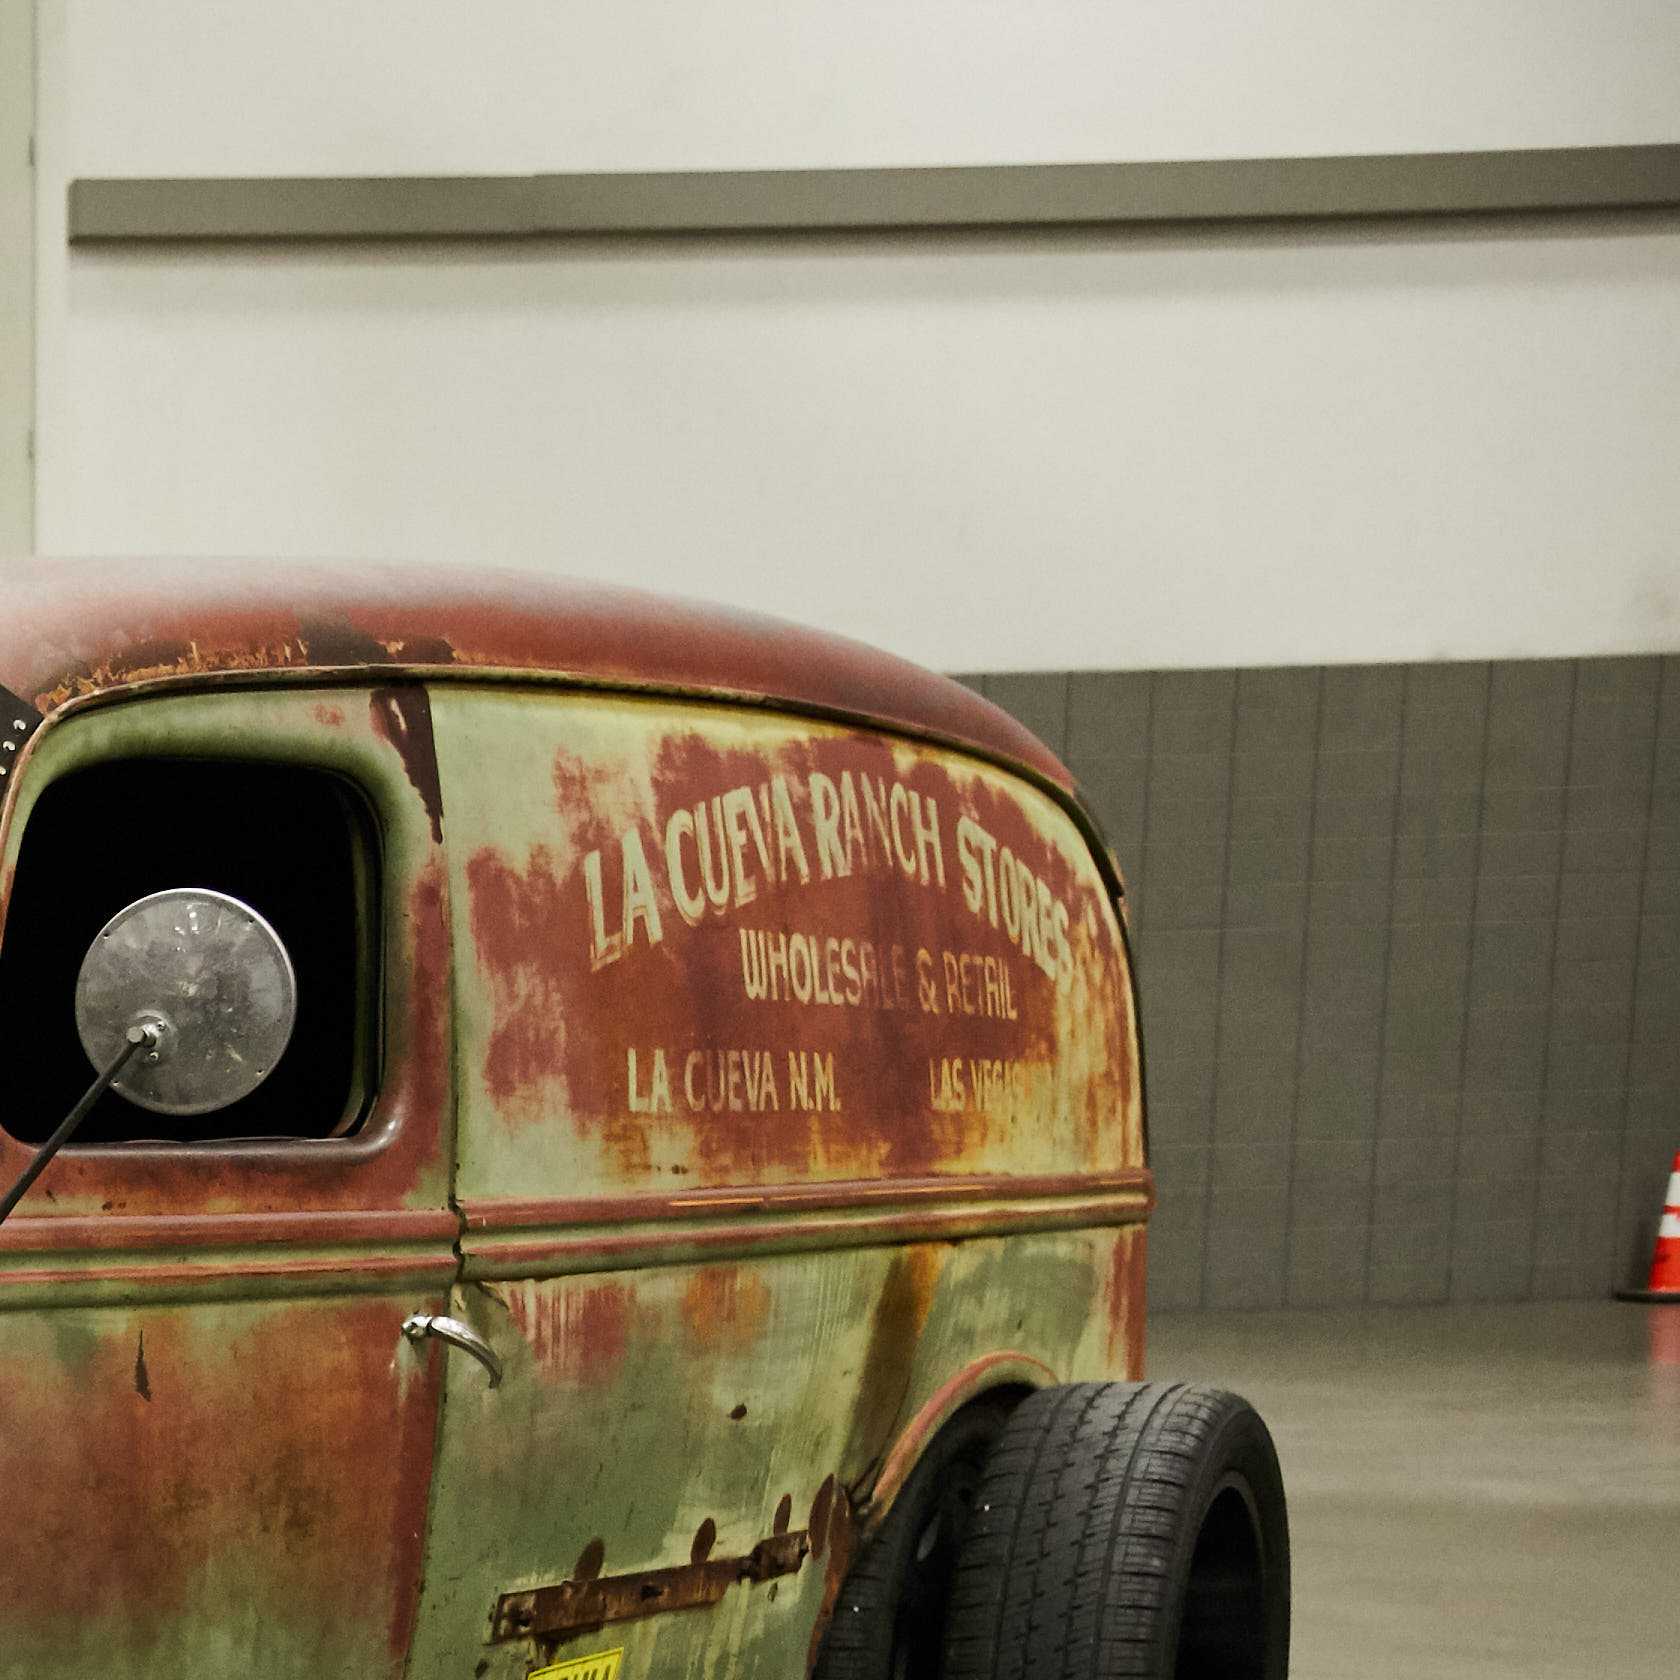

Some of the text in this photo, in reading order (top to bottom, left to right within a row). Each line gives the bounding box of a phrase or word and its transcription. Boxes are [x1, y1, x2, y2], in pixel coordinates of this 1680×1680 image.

[583, 827, 663, 972] LA
[665, 774, 810, 926] CUEVA
[808, 769, 946, 888] RANCH
[942, 950, 1019, 1021] RETAIL
[627, 1047, 673, 1113] LA
[684, 1049, 779, 1113] CUEVA
[929, 1056, 966, 1112] LAS
